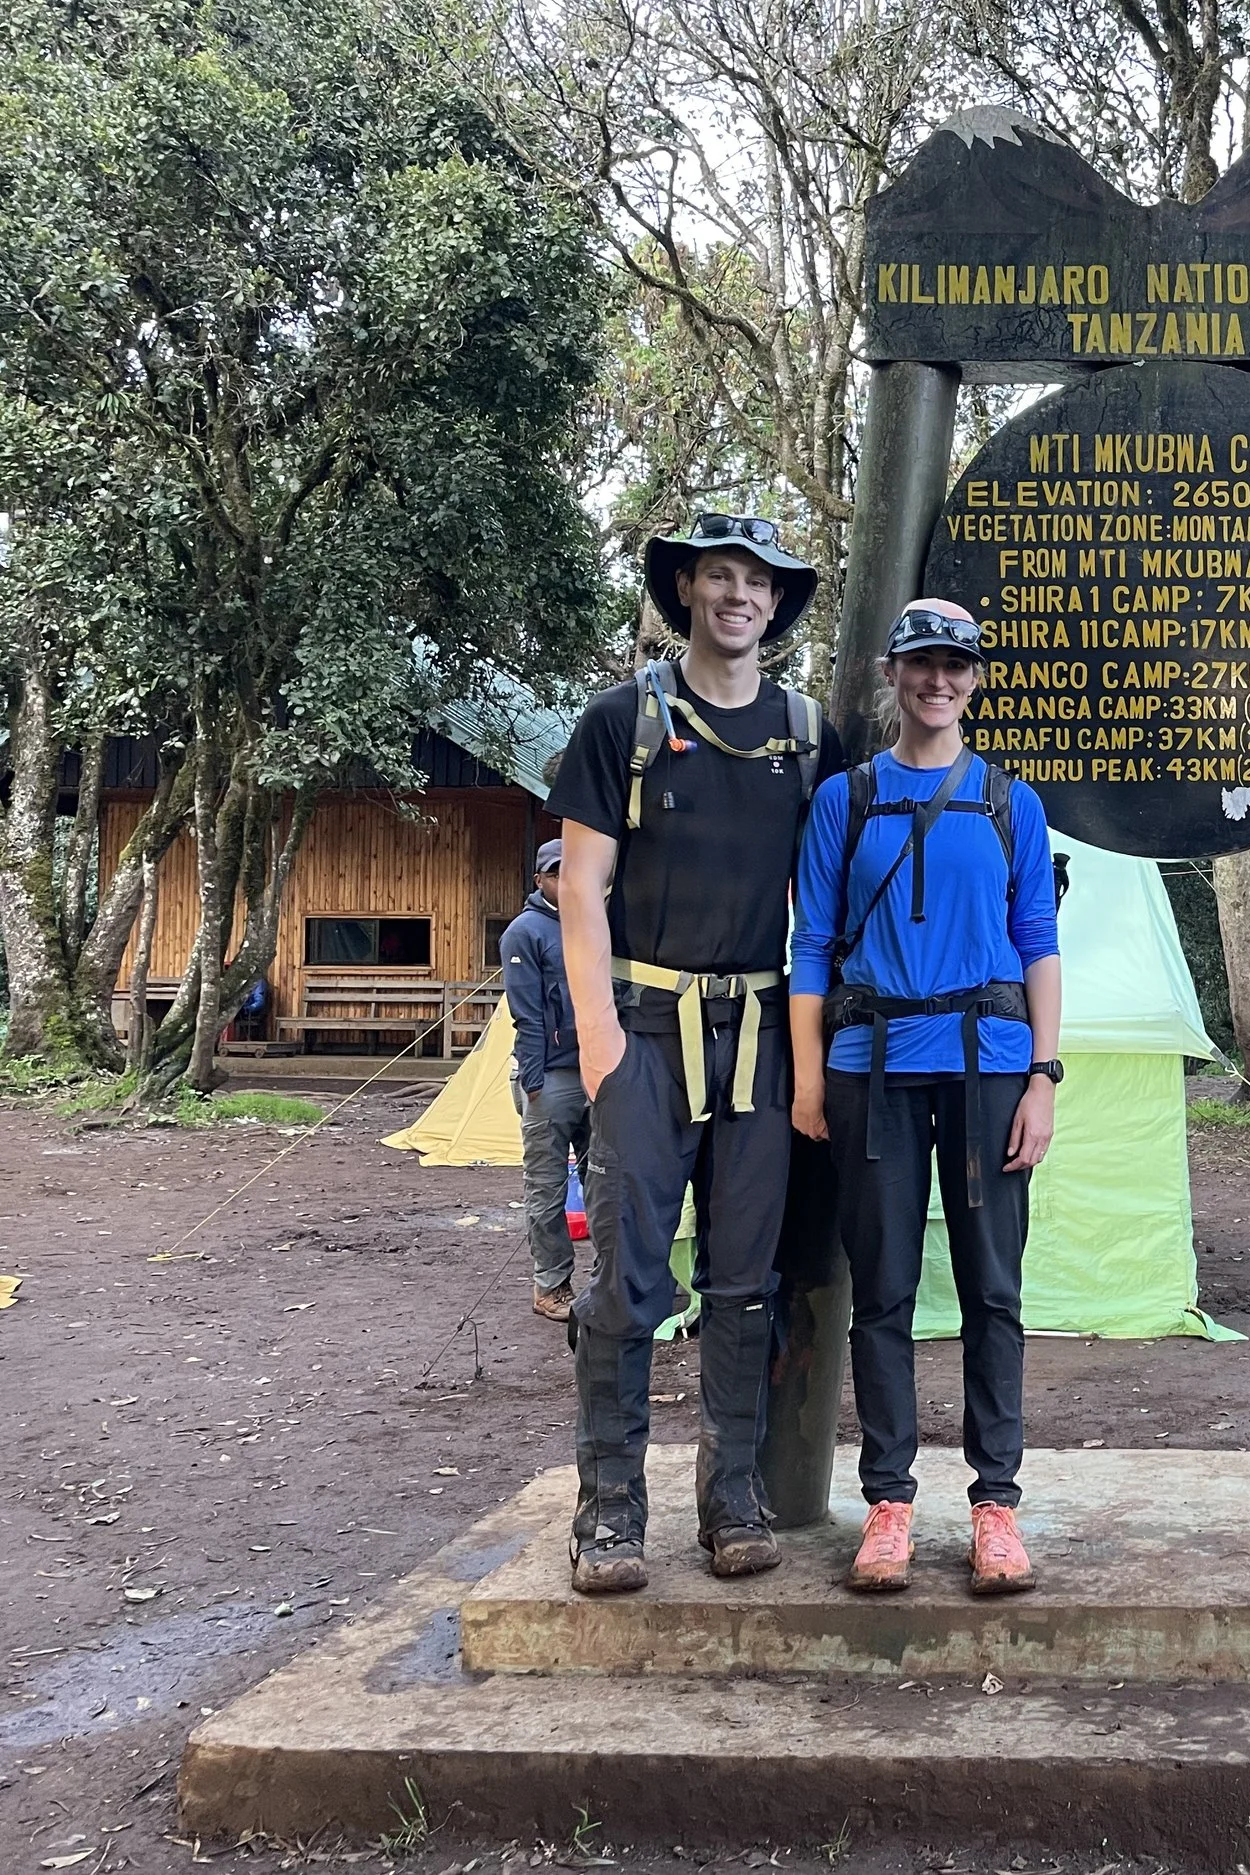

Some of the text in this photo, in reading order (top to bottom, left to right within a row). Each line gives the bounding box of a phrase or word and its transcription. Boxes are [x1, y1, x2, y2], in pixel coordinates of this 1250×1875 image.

[878, 263, 1109, 305] KILIMANJARO
[1067, 312, 1246, 356] TANZANIA
[1029, 434, 1080, 474] MTI
[1094, 434, 1215, 474] MKUBWA
[966, 480, 1153, 508] ELEVATION:
[946, 514, 1093, 542] VEGETATION
[999, 548, 1067, 579] FROM
[1079, 548, 1127, 578] MTI
[980, 619, 1071, 649] SHIRA
[975, 727, 1071, 751] BARAFU
